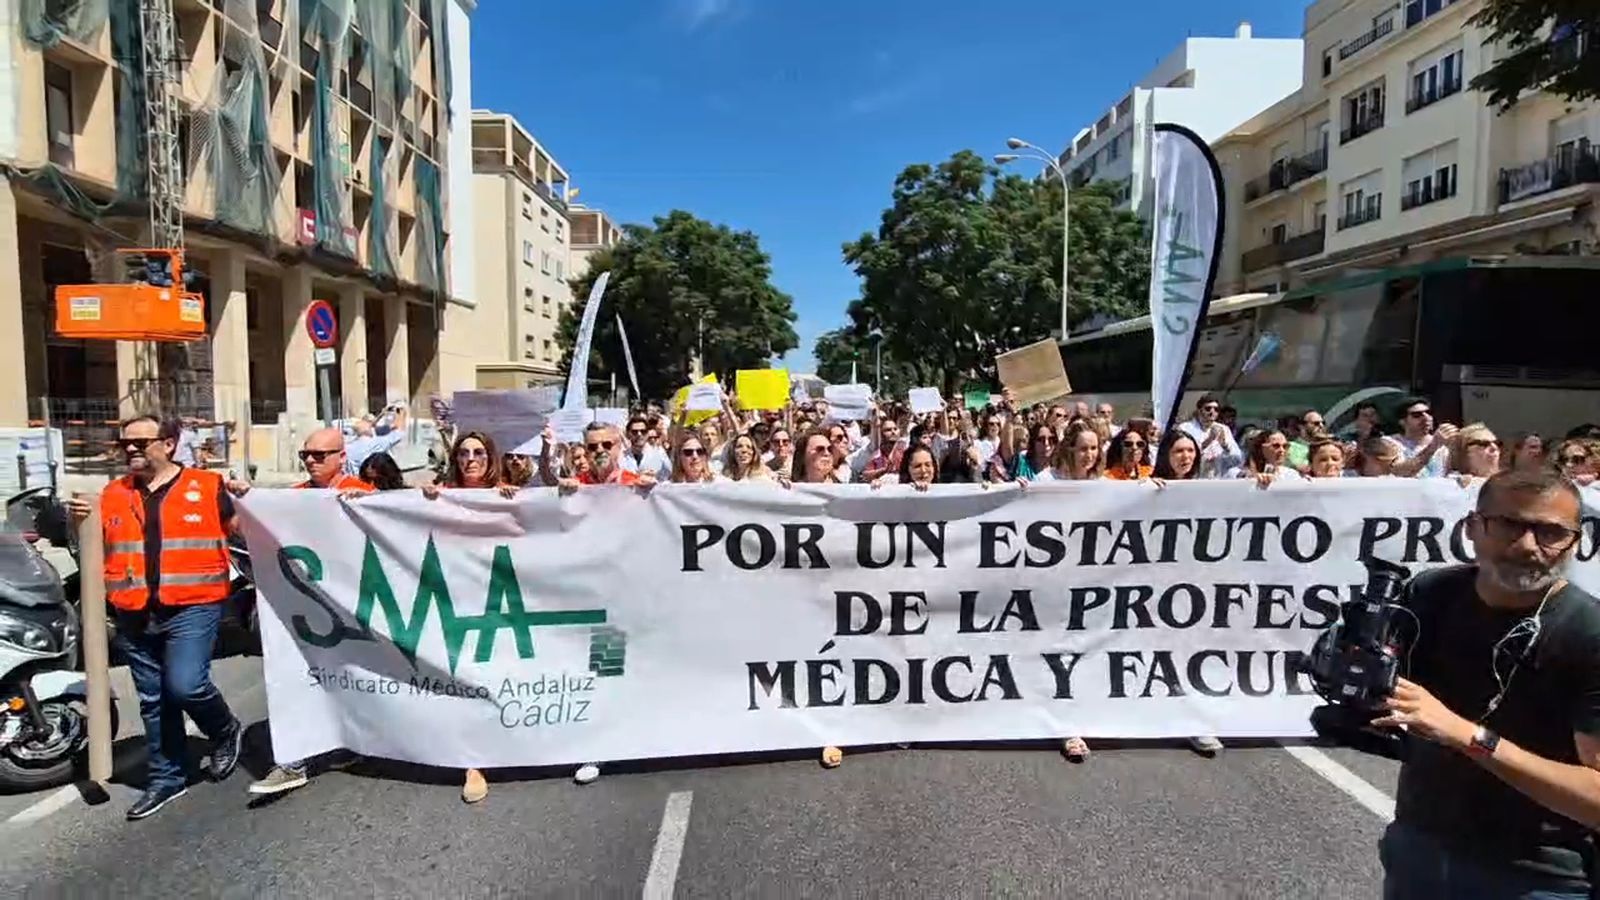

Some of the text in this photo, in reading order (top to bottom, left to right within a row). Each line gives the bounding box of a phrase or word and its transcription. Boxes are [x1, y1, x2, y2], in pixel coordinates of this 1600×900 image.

[680, 523, 831, 572] POR
[855, 521, 947, 568] UN
[979, 519, 1332, 567] ESTATUTO
[834, 590, 930, 636] DE
[958, 589, 1041, 634] LA
[308, 666, 596, 700] Sindicato Médico Andaluz
[746, 639, 1023, 711] MÉDICA
[1042, 652, 1082, 700] Y
[499, 690, 592, 730] Cádiz
